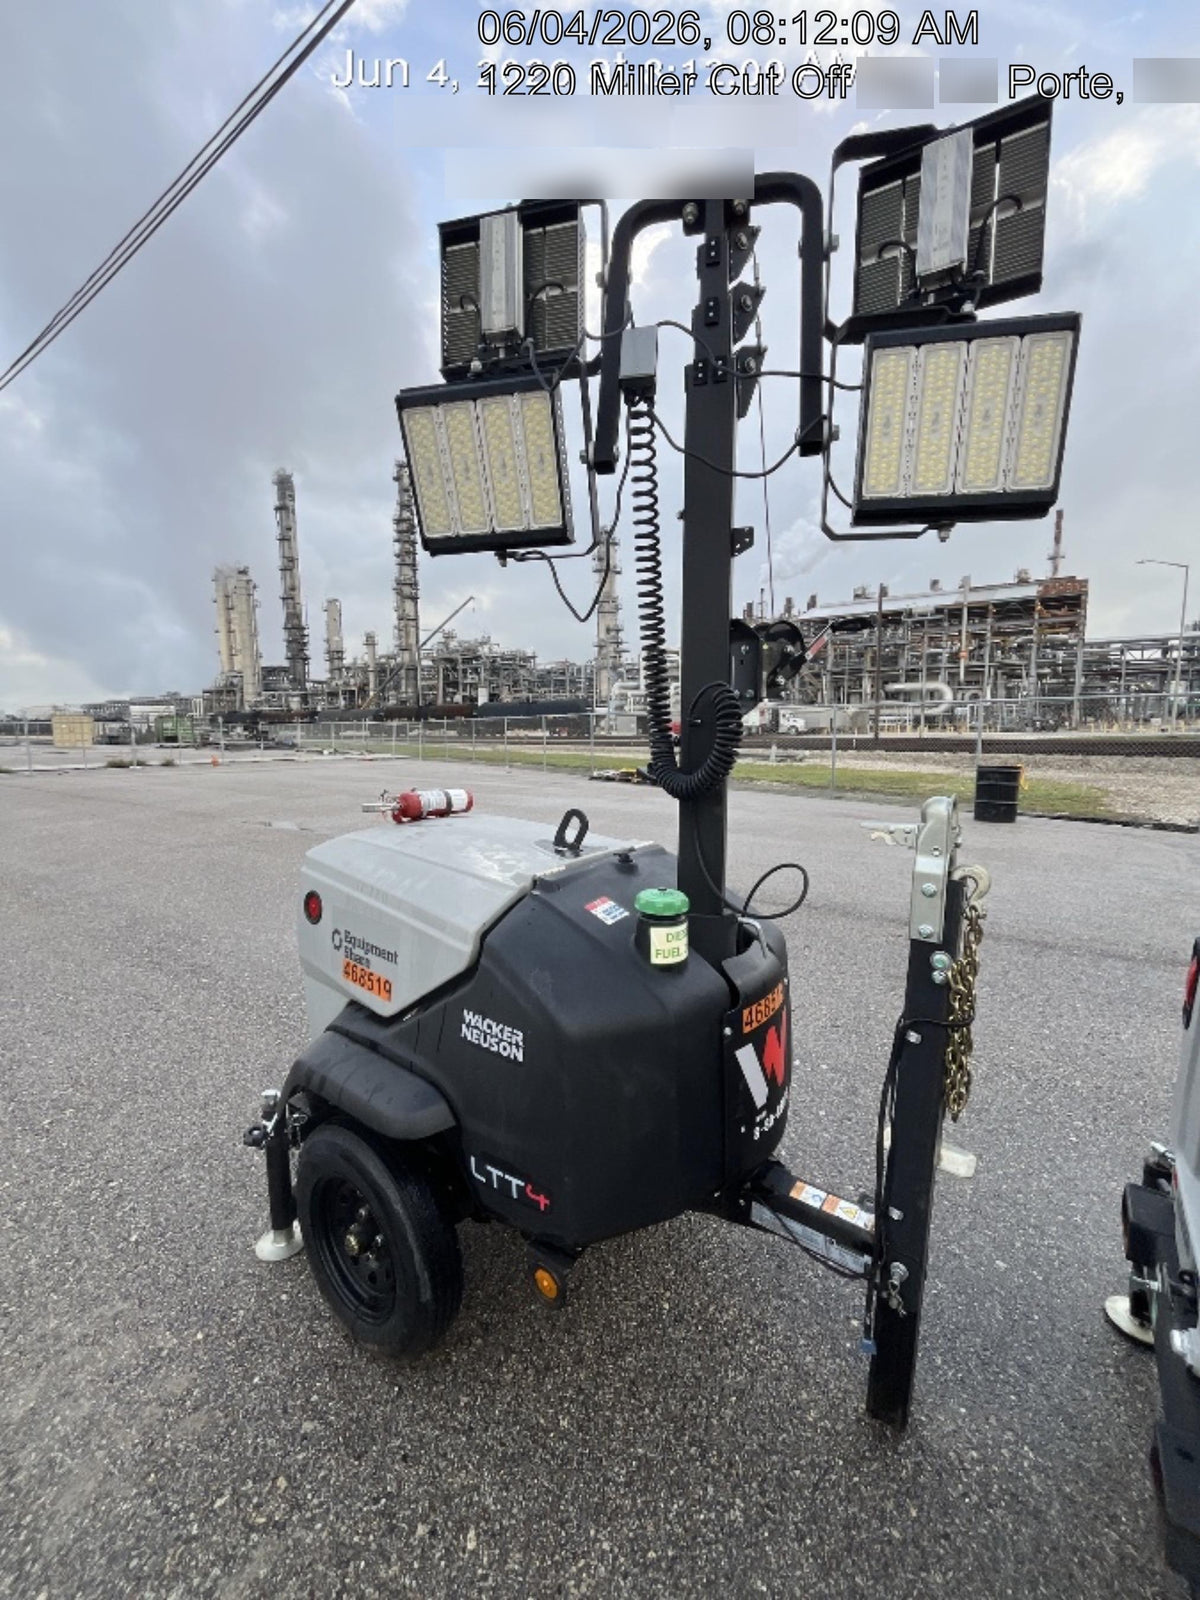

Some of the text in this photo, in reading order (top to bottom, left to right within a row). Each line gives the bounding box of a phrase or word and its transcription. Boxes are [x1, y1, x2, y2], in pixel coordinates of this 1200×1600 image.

[655, 946, 680, 959] FUEL
[343, 961, 393, 1002] 468519
[460, 1023, 524, 1063] NEUSON
[463, 1008, 525, 1048] WACKER
[470, 1155, 550, 1211] LTT4
